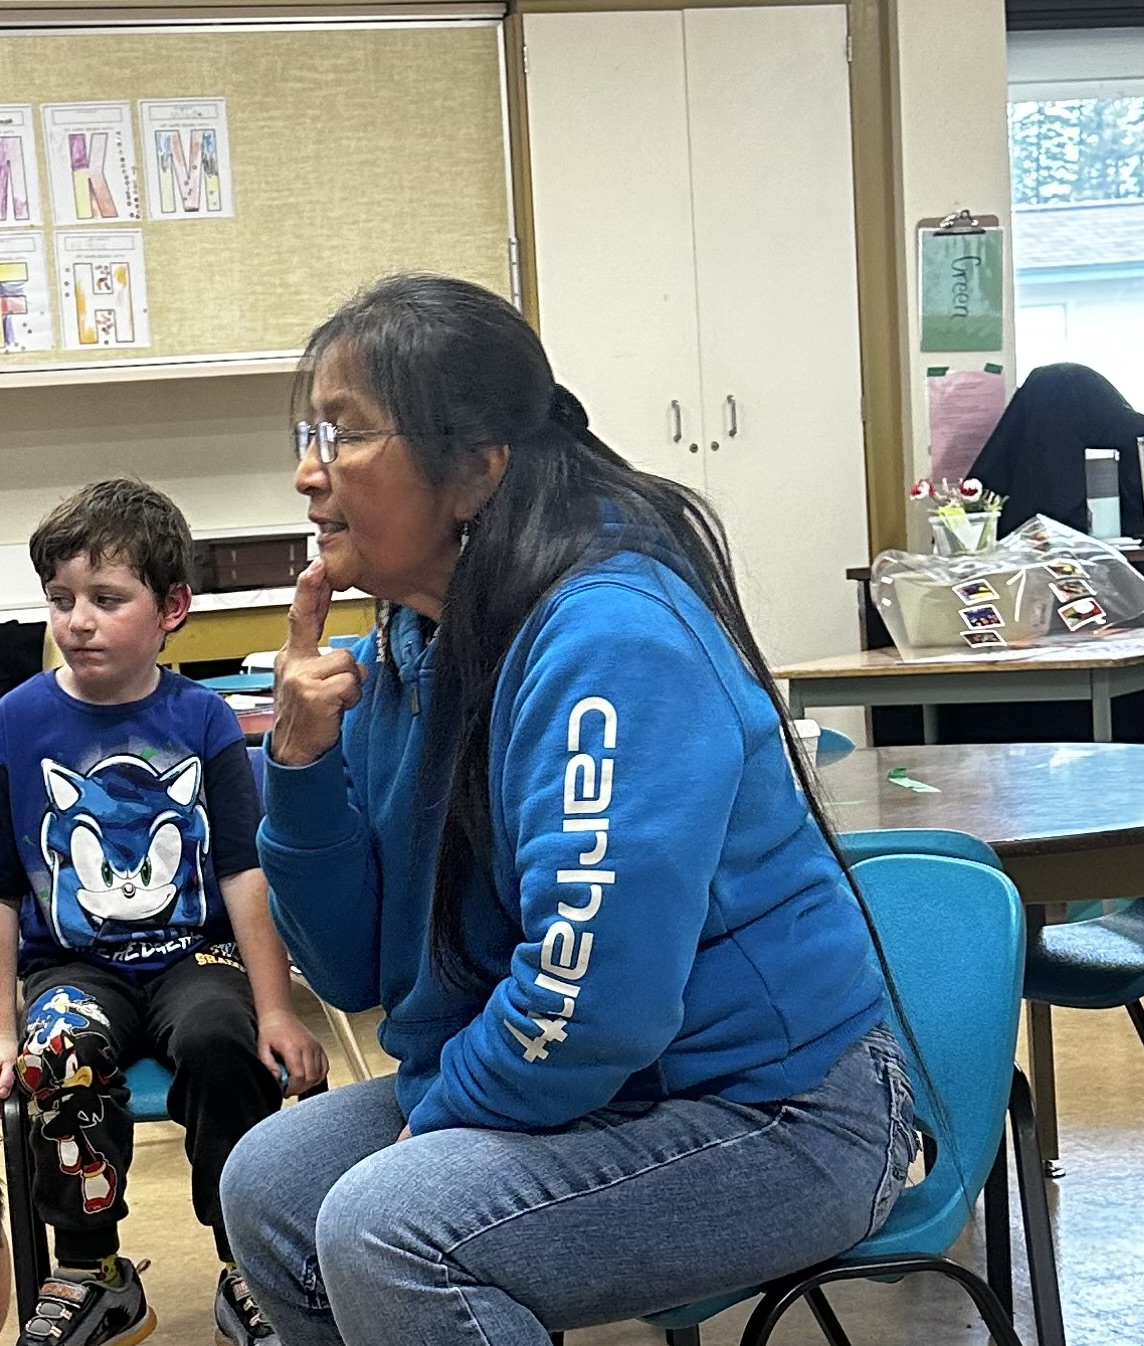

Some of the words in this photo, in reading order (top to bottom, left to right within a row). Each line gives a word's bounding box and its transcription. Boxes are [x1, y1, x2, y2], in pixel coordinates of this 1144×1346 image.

[68, 132, 119, 220] K
[155, 128, 222, 213] M
[73, 262, 135, 345] H
[950, 255, 982, 320] Green
